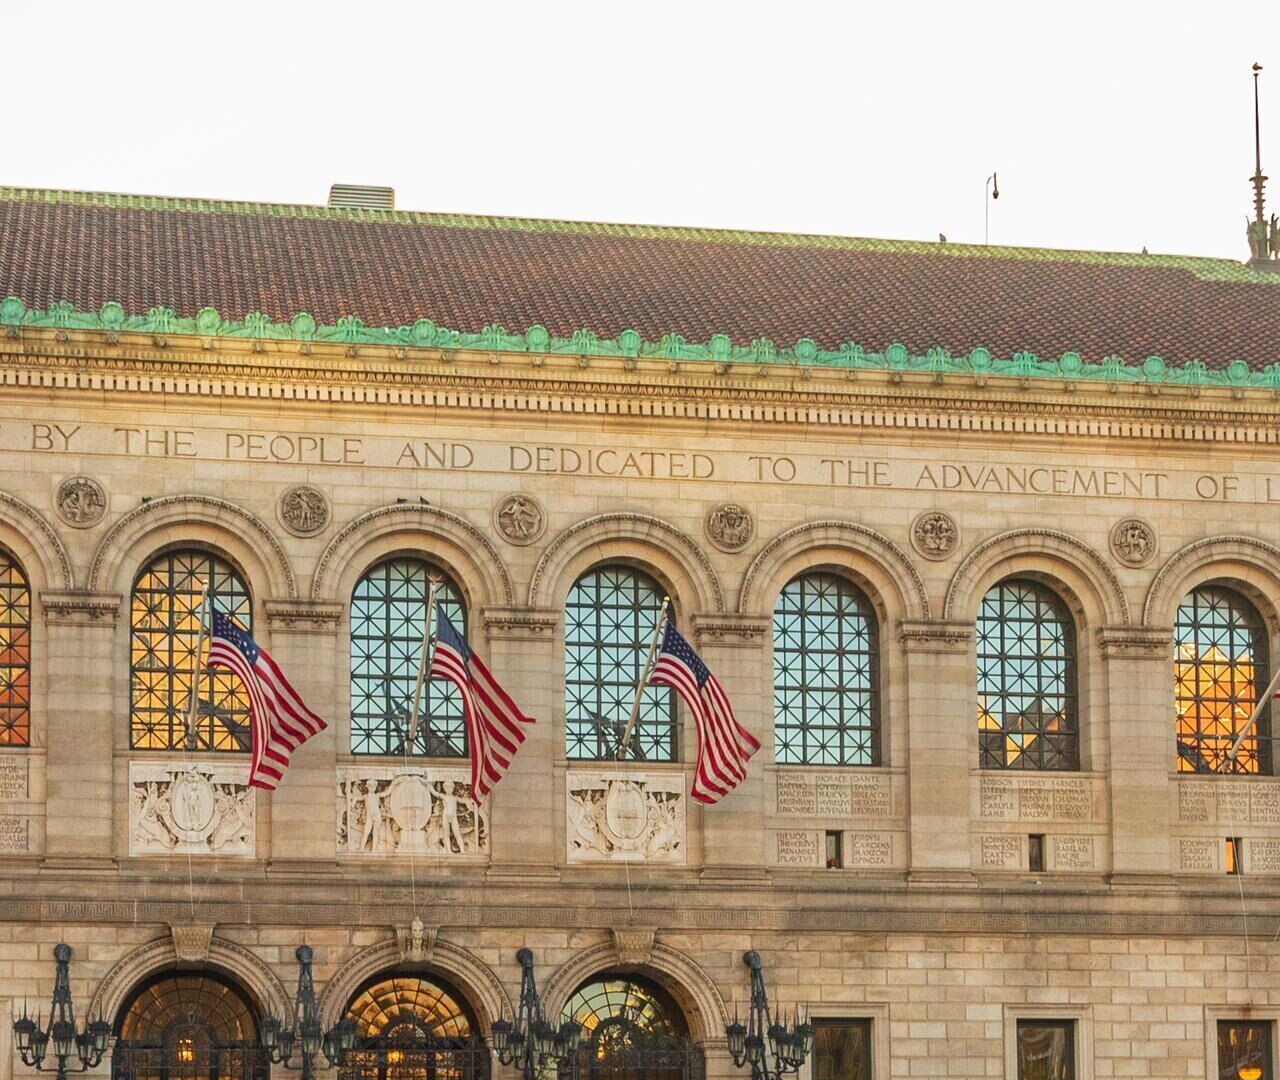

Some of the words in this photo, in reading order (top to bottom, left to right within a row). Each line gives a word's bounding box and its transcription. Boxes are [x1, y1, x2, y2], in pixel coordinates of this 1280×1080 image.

[32, 424, 81, 452] BY
[114, 428, 198, 457] THE
[225, 433, 365, 464] PEOPLE
[396, 442, 474, 469] AND
[509, 446, 714, 479] DEDICATED
[749, 456, 796, 482] TO
[821, 459, 893, 487] THE
[915, 465, 1168, 497] ADVANCEMENT
[1196, 476, 1239, 500] OF
